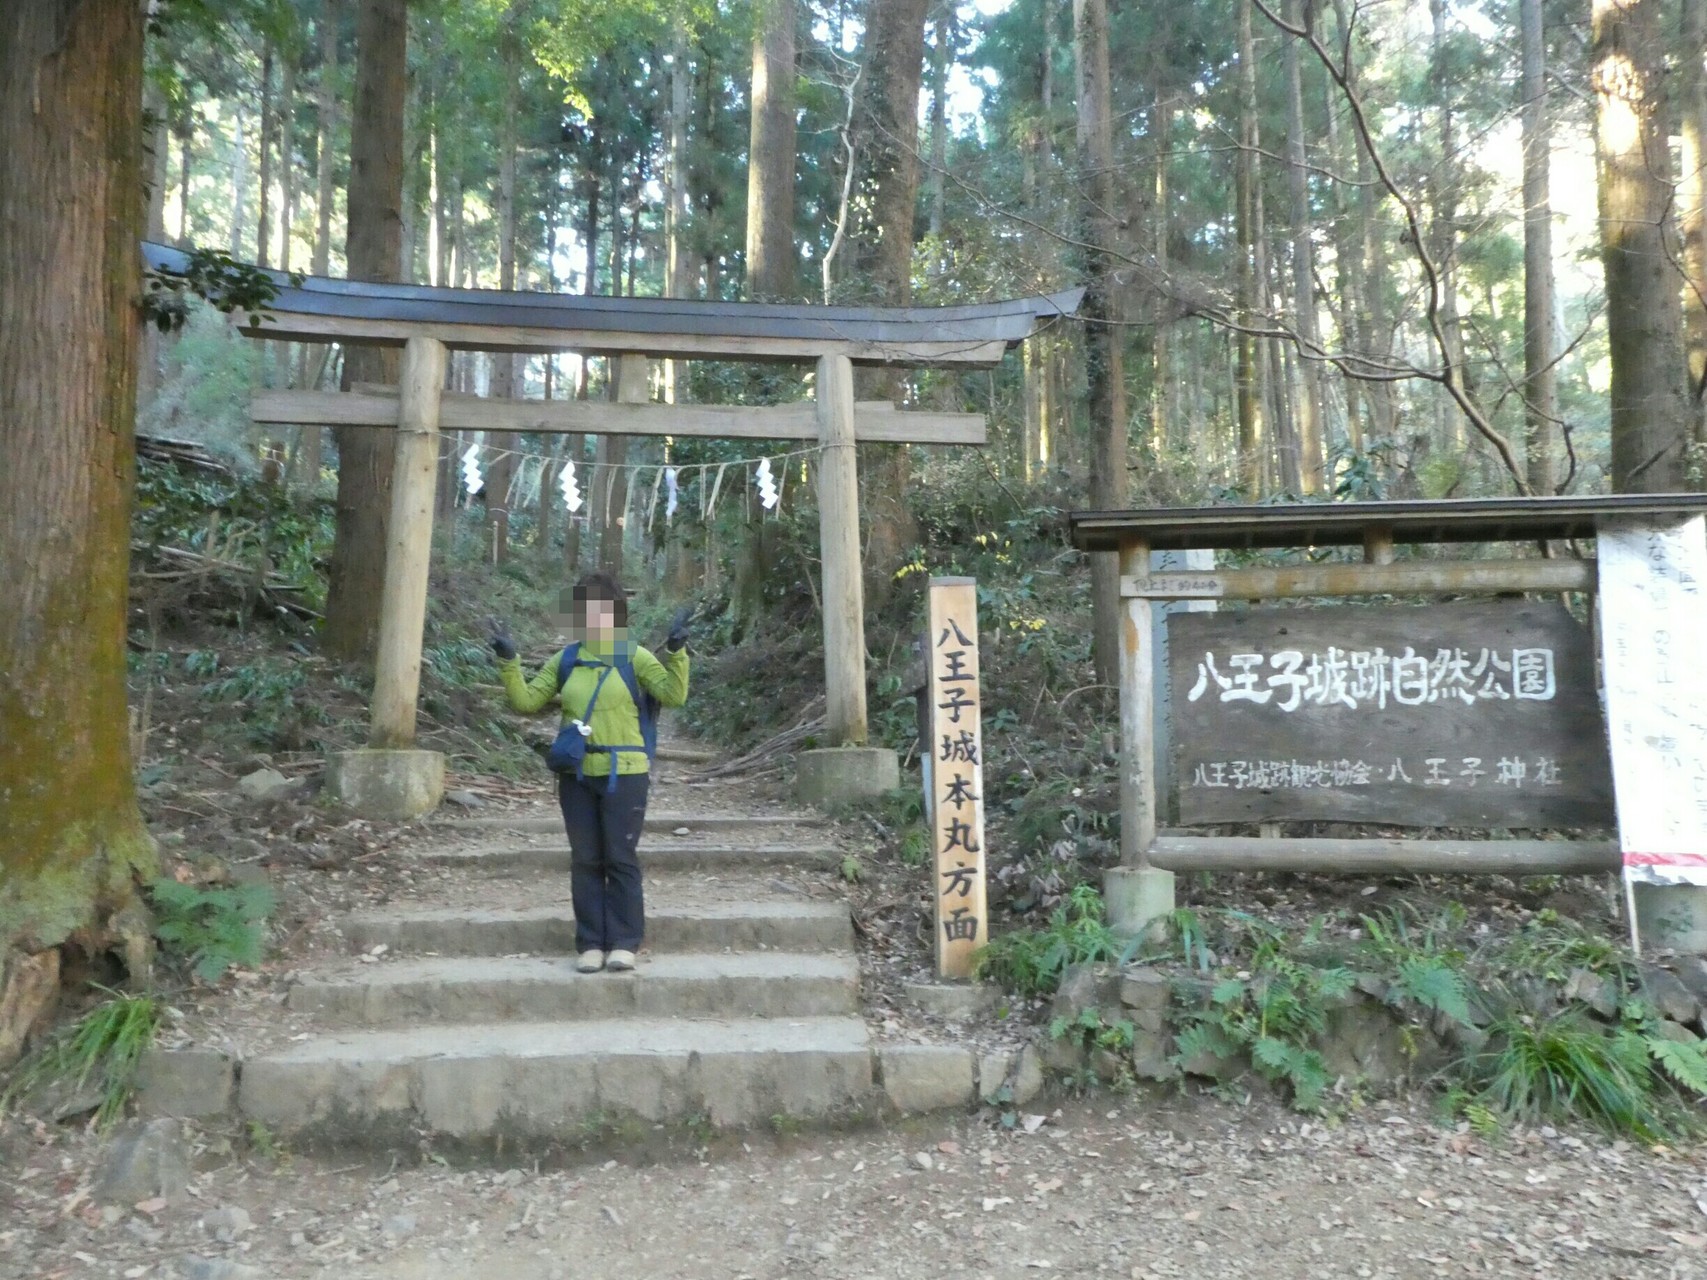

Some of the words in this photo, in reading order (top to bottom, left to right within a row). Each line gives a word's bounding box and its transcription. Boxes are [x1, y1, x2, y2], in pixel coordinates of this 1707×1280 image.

[1188, 645, 1556, 712] 八王子城跡自然公園
[936, 618, 981, 943] 八王子城本丸方面
